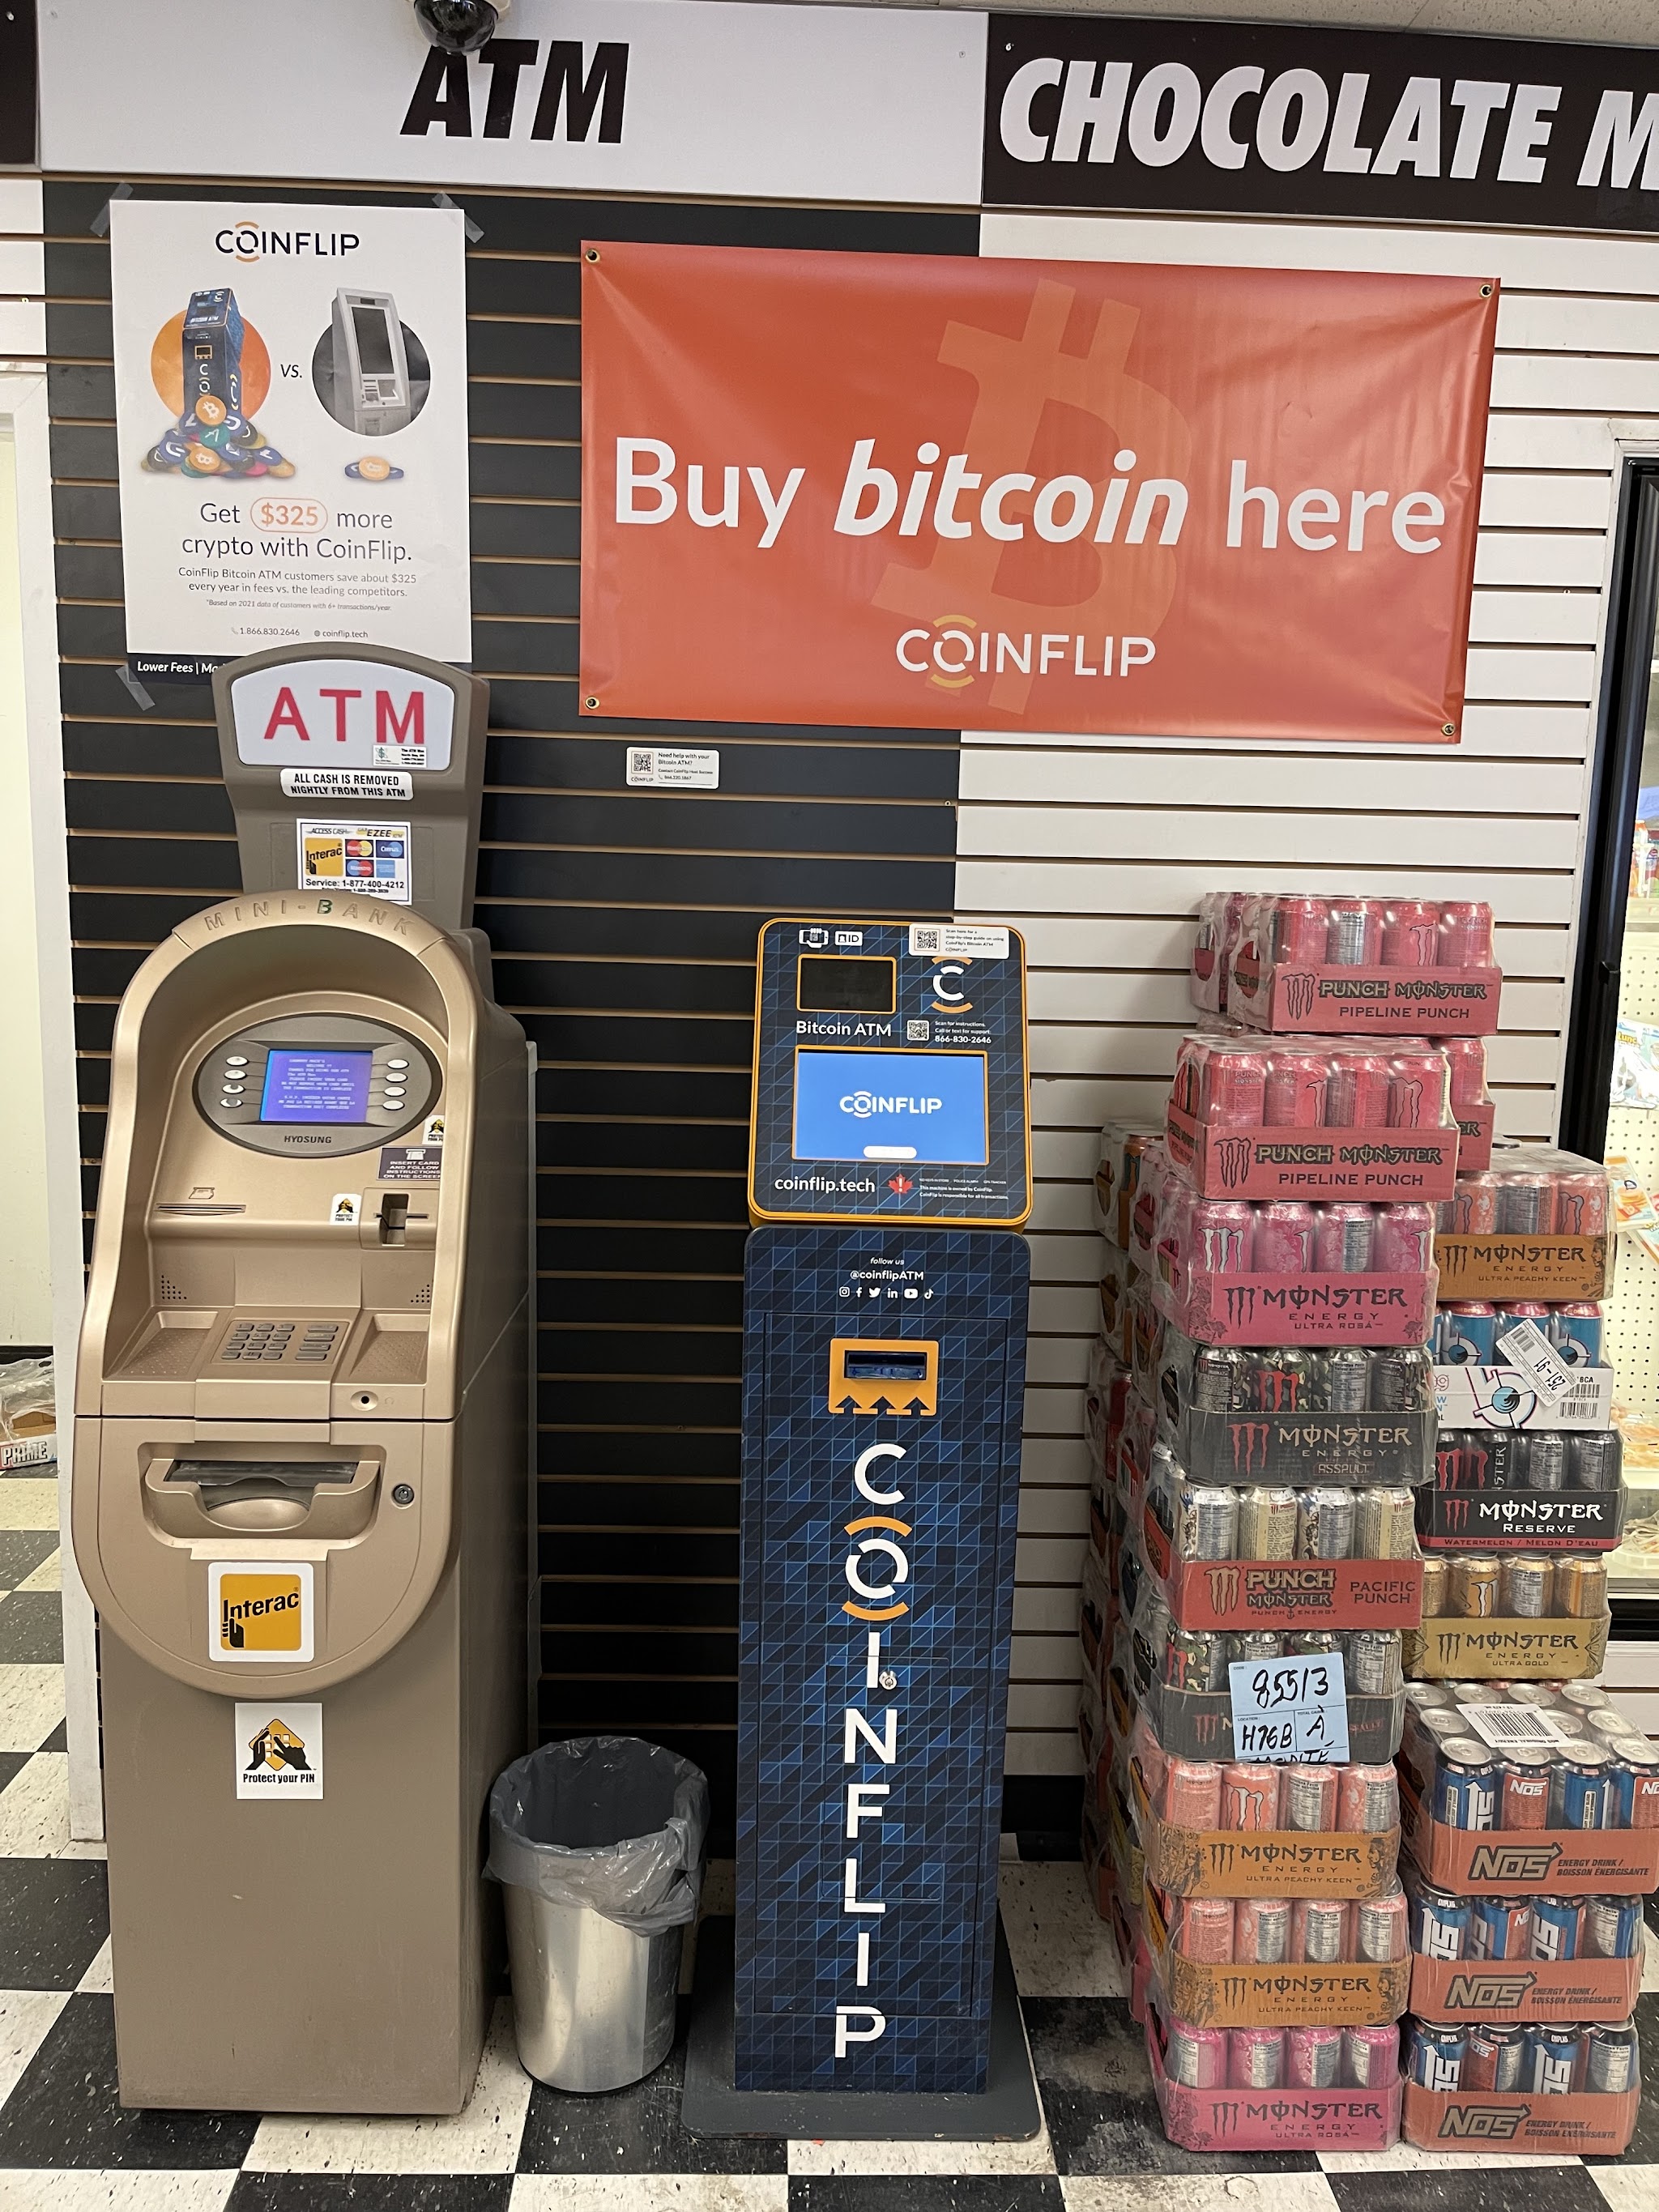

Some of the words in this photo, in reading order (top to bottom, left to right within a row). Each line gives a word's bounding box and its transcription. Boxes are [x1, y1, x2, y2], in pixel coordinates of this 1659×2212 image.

[400, 39, 629, 143] ATM
[1000, 57, 1563, 184] CHOCOLATE
[215, 227, 360, 258] COINFLIP
[616, 437, 806, 548] Buy
[834, 438, 1189, 546] bitcoin
[1226, 459, 1445, 554] here
[200, 502, 241, 524] Get
[260, 502, 319, 526] $325
[336, 510, 393, 529] more
[182, 536, 254, 559] crypto
[260, 536, 309, 557] with
[316, 538, 412, 564] CoinFlip.
[178, 567, 219, 578] CoinFlip
[222, 569, 256, 579] Bitcoin
[258, 570, 282, 580] ATM
[284, 572, 334, 582] customers
[361, 573, 389, 582] about
[392, 573, 416, 583] $325
[189, 583, 216, 592] every
[218, 584, 240, 593] year
[242, 583, 250, 592] in
[254, 583, 274, 593] fees
[276, 586, 289, 594] vs.
[292, 585, 308, 594] the
[310, 585, 345, 597] leading
[348, 586, 407, 598] competitors.
[240, 627, 301, 636] 1.866.830.2646
[322, 629, 369, 638] coinflip.tech
[896, 623, 1156, 683] COINFLIP
[137, 660, 168, 673] Lower
[170, 661, 194, 674] Fees
[263, 686, 425, 744] ATM
[294, 773, 311, 783] ALL
[313, 774, 339, 784] CASH
[341, 774, 351, 784] IS
[353, 775, 399, 786] REMOVED
[290, 786, 329, 795] NIGHTLY
[331, 786, 360, 795] FROM
[361, 787, 383, 796] THIS
[386, 788, 406, 797] ATM
[366, 829, 392, 837] EZEE
[306, 846, 343, 862] Interac
[305, 878, 340, 887] Service:
[342, 880, 405, 889] 1-877-400-4212
[1320, 980, 1389, 998] PUNCH
[1395, 982, 1488, 1000] MONSTER
[1339, 1006, 1411, 1018] PIPELINE
[1417, 1008, 1470, 1019] PUNCH
[795, 1020, 851, 1037] Bitcoin
[853, 1022, 892, 1038] ATM
[934, 1035, 992, 1044] 866-830-2646
[840, 1093, 942, 1116] COINFLIP
[284, 1136, 332, 1144] HYOSUNG
[1256, 1144, 1333, 1165] PUNCH
[1341, 1144, 1444, 1166] MONSTER
[774, 1175, 876, 1194] coinflip.tech
[1278, 1174, 1358, 1185] PIPELINE
[1364, 1174, 1423, 1187] PUNCH
[870, 1257, 894, 1265] follow
[1473, 1243, 1586, 1264] MONSTER
[850, 1269, 924, 1282] @coinflipATM
[1263, 1285, 1409, 1310] MONSTER
[1289, 1313, 1380, 1321] ENERGY
[1279, 1424, 1412, 1448] MONSTER
[2, 1440, 48, 1465] PRIME
[1303, 1449, 1388, 1457] ENERGY
[1318, 1463, 1368, 1474] ASSAULT
[1479, 1500, 1603, 1522] MONSTER
[1503, 1524, 1576, 1533] RESERVE
[1444, 1539, 1513, 1547] WATERMELON
[1566, 1540, 1599, 1548] D'EAU
[1246, 1568, 1337, 1592] PUNCH
[1350, 1580, 1416, 1592] PACIFIC
[1247, 1592, 1333, 1608] MONSTER
[1354, 1592, 1411, 1605] PUNCH
[223, 1592, 300, 1622] Interac
[1466, 1631, 1579, 1651] MONSTER
[1241, 1723, 1293, 1752] H76B
[834, 1443, 909, 2059] COINFLIP
[243, 1774, 276, 1783] Protect
[277, 1775, 298, 1784] your
[301, 1774, 315, 1783] PIN
[1509, 1779, 1547, 1796] NOS
[1240, 1843, 1363, 1864] MONSTER
[1468, 1843, 1563, 1881] NOS
[1558, 1859, 1590, 1867] ENERGY
[1592, 1859, 1618, 1867] DRINK
[1557, 1868, 1593, 1877] BOISSON
[1594, 1865, 1650, 1877] ÉNERGISANTE
[1253, 1975, 1372, 1994] MONSTER
[1444, 1971, 1537, 2010] NOS
[1532, 1988, 1563, 1996] ENERGY
[1566, 1988, 1591, 1996] DRINK
[1531, 1996, 1566, 2005] BOISSON
[1247, 2100, 1383, 2120] MONSTER
[1438, 2103, 1531, 2140] NOS
[1526, 2120, 1557, 2129] ENERGY
[1559, 2120, 1584, 2129] DRINK
[1525, 2129, 1560, 2137] BOISSON
